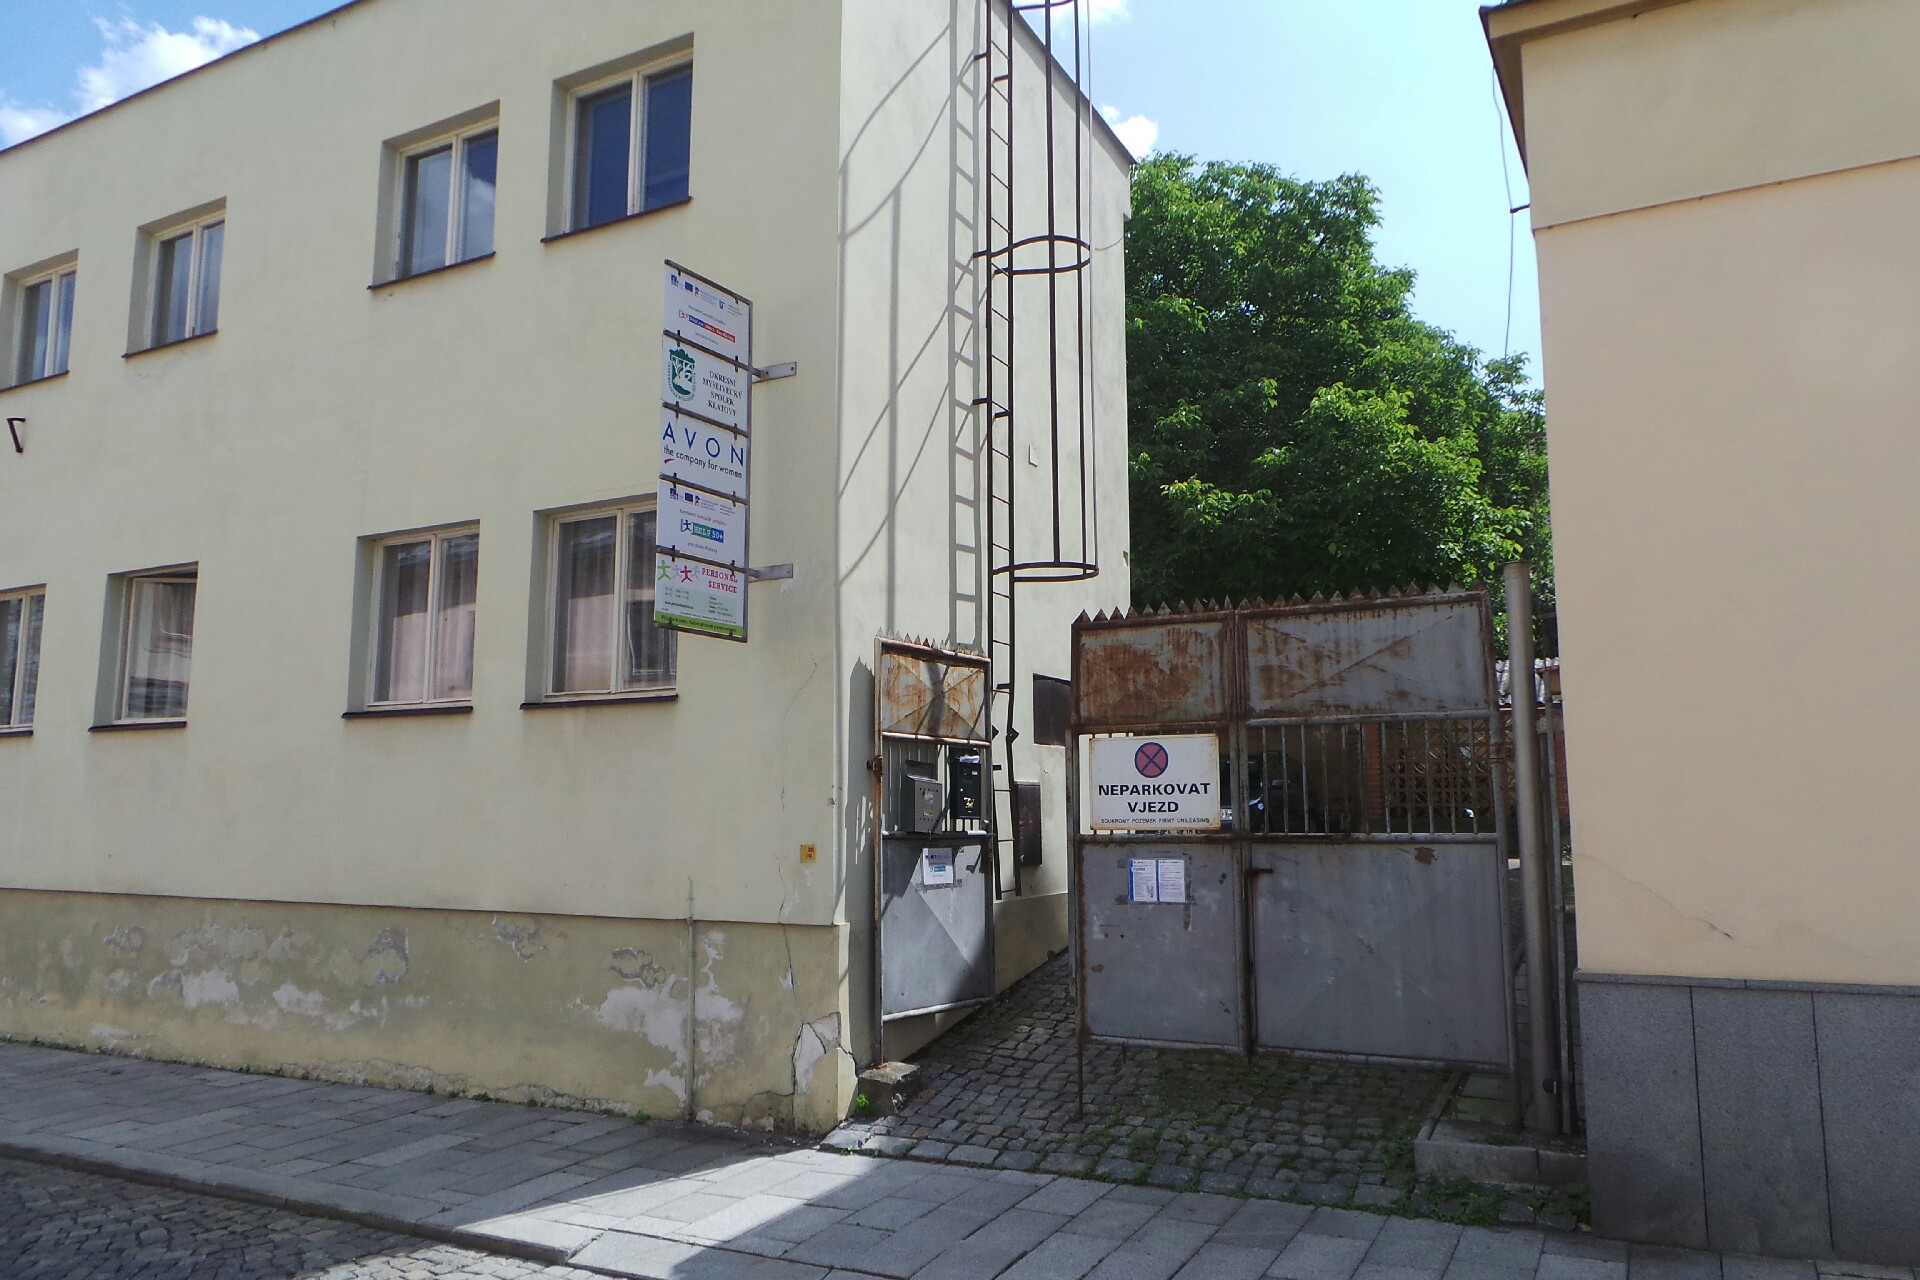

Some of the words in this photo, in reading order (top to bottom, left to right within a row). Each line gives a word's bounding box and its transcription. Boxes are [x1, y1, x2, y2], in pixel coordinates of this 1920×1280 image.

[710, 391, 735, 406] SPOLEK
[708, 400, 737, 416] KLATOVY
[663, 421, 744, 467] AVON
[663, 445, 674, 457] the
[676, 451, 706, 469] company
[708, 458, 718, 471] for
[719, 465, 742, 478] women
[701, 567, 738, 583] PERSONAL
[708, 581, 738, 594] SERVICE
[1098, 782, 1211, 796] NEPARKOVAT
[1127, 801, 1179, 813] VJEZD
